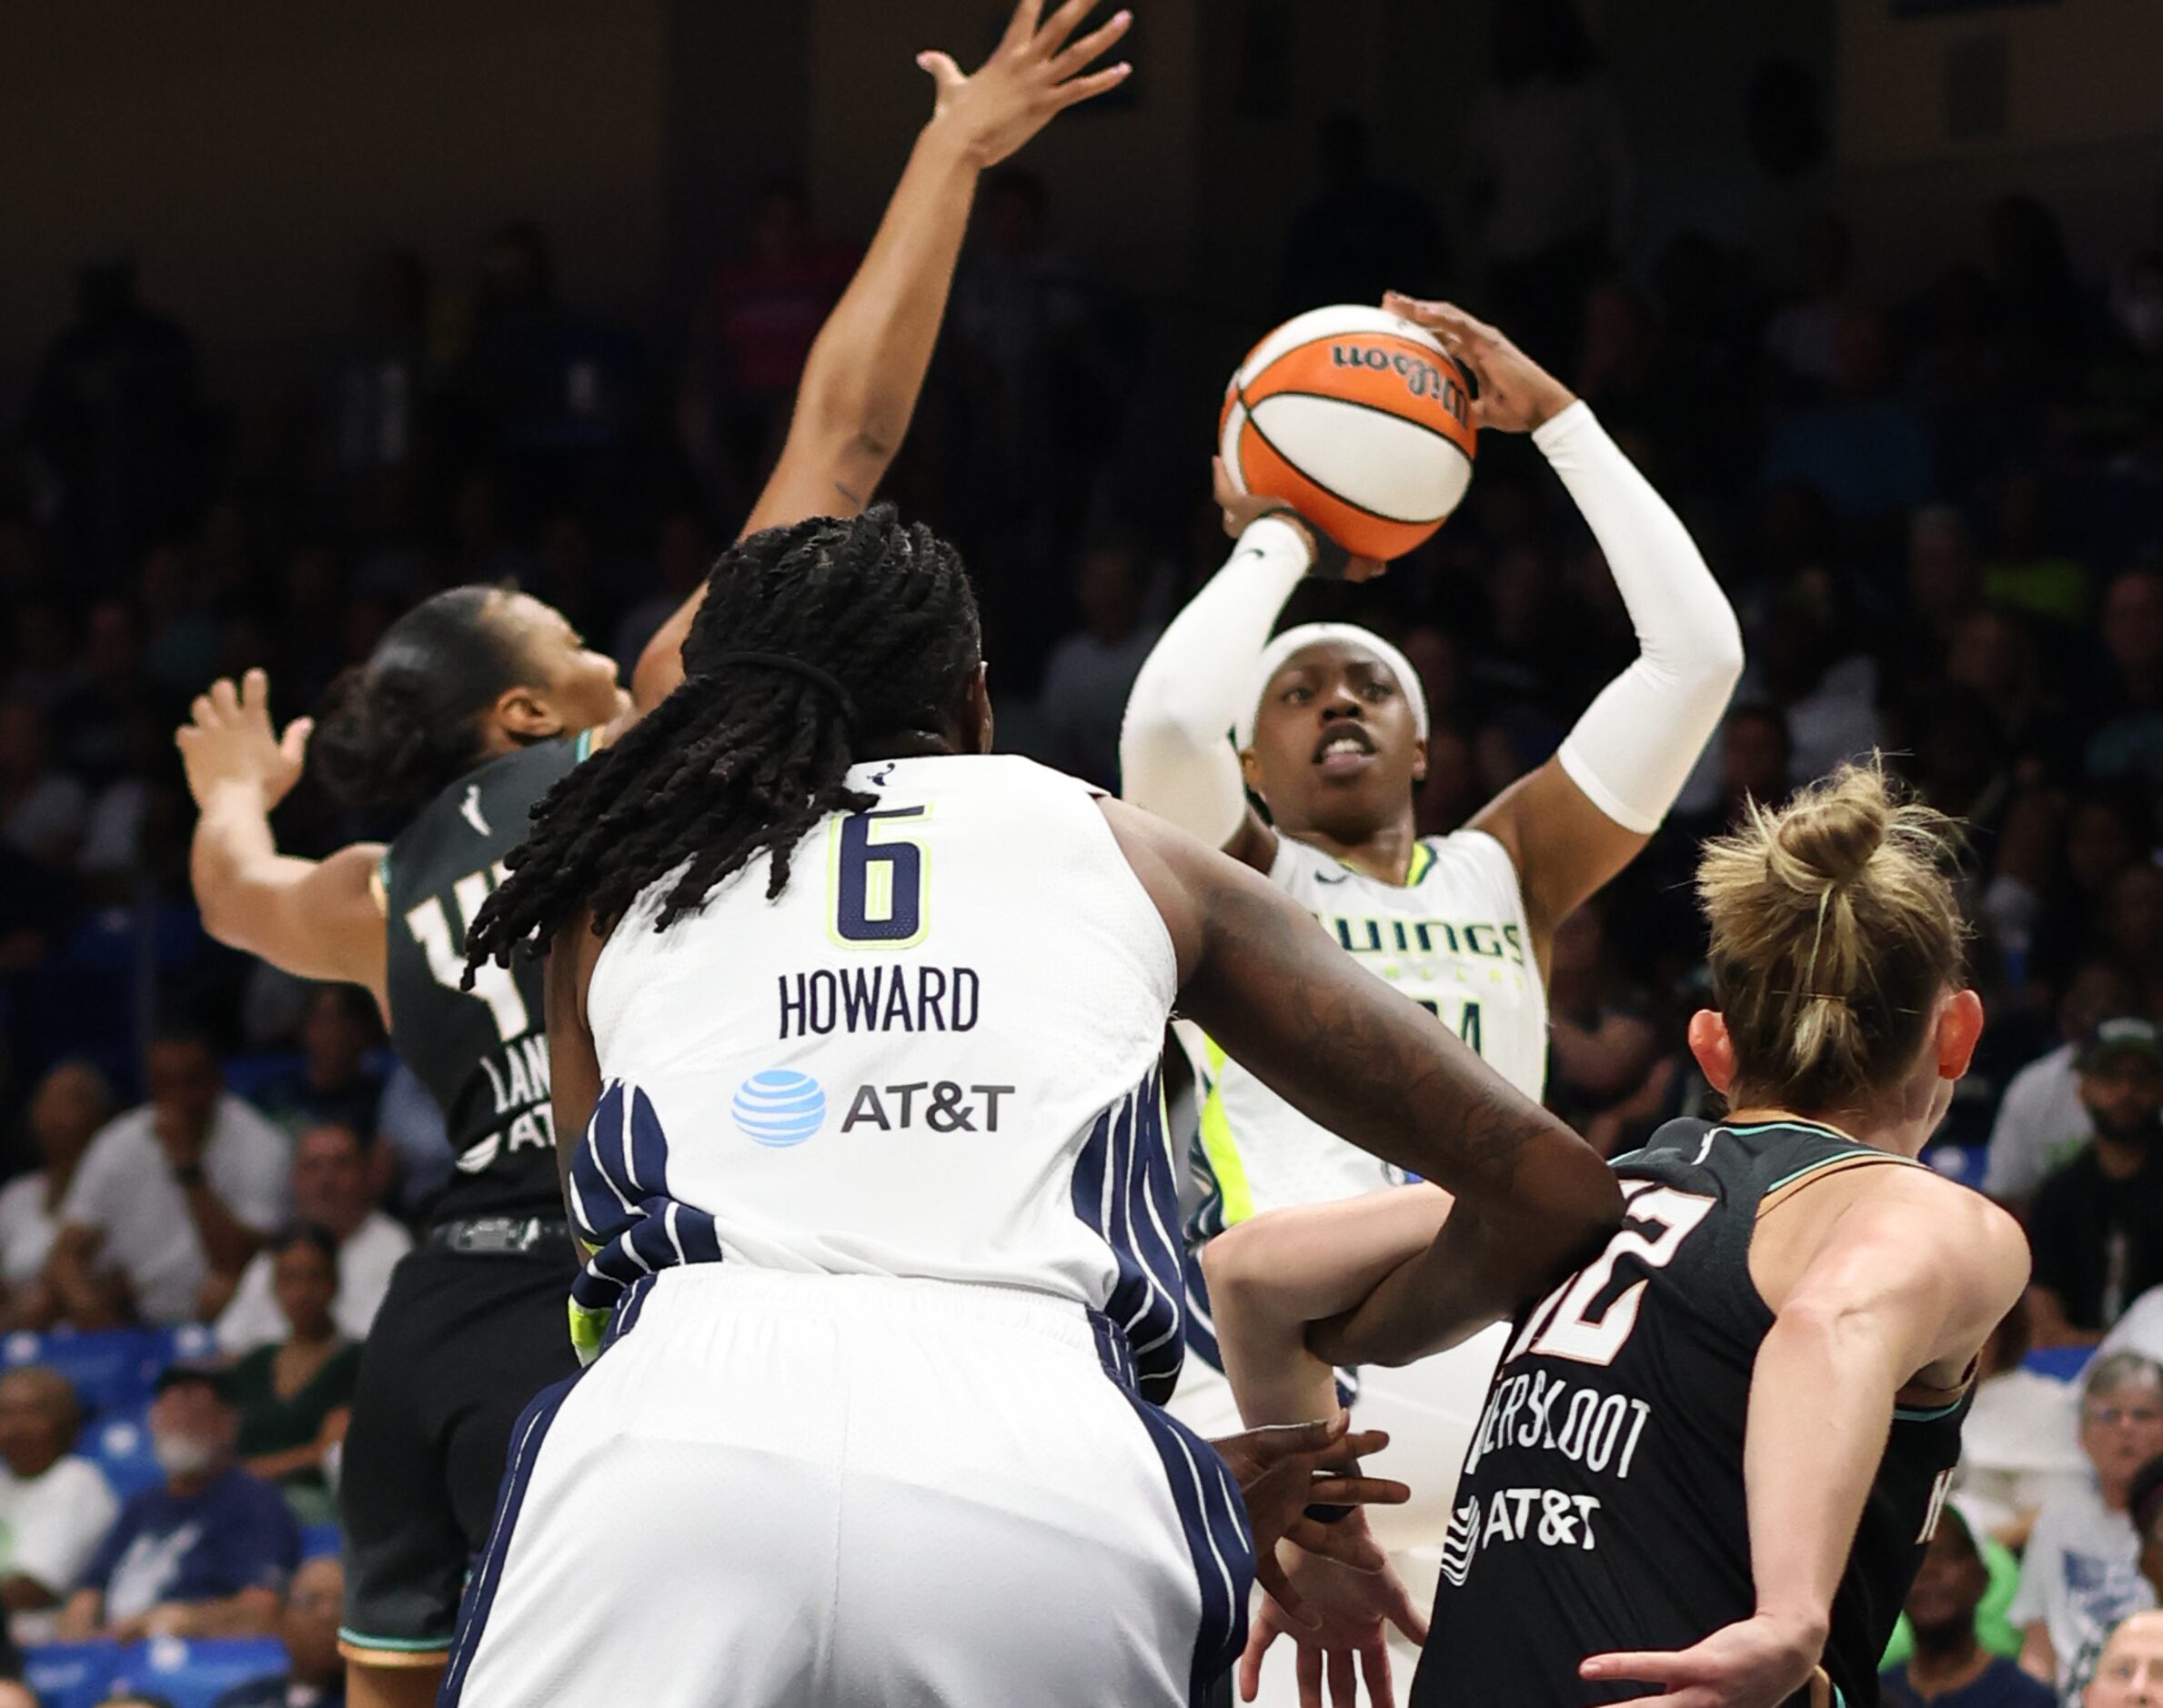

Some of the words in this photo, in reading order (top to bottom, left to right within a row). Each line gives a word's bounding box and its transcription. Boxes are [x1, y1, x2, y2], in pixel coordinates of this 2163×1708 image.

[1333, 344, 1470, 429] Wilson
[828, 802, 934, 949] 6
[779, 964, 980, 1040] HOWARD
[480, 1033, 550, 1114] LAN
[840, 1080, 1016, 1133] AT&T
[1503, 1179, 1717, 1366] 2
[1464, 1369, 1652, 1479] ERSLOOT
[1483, 1488, 1602, 1551] AT&T
